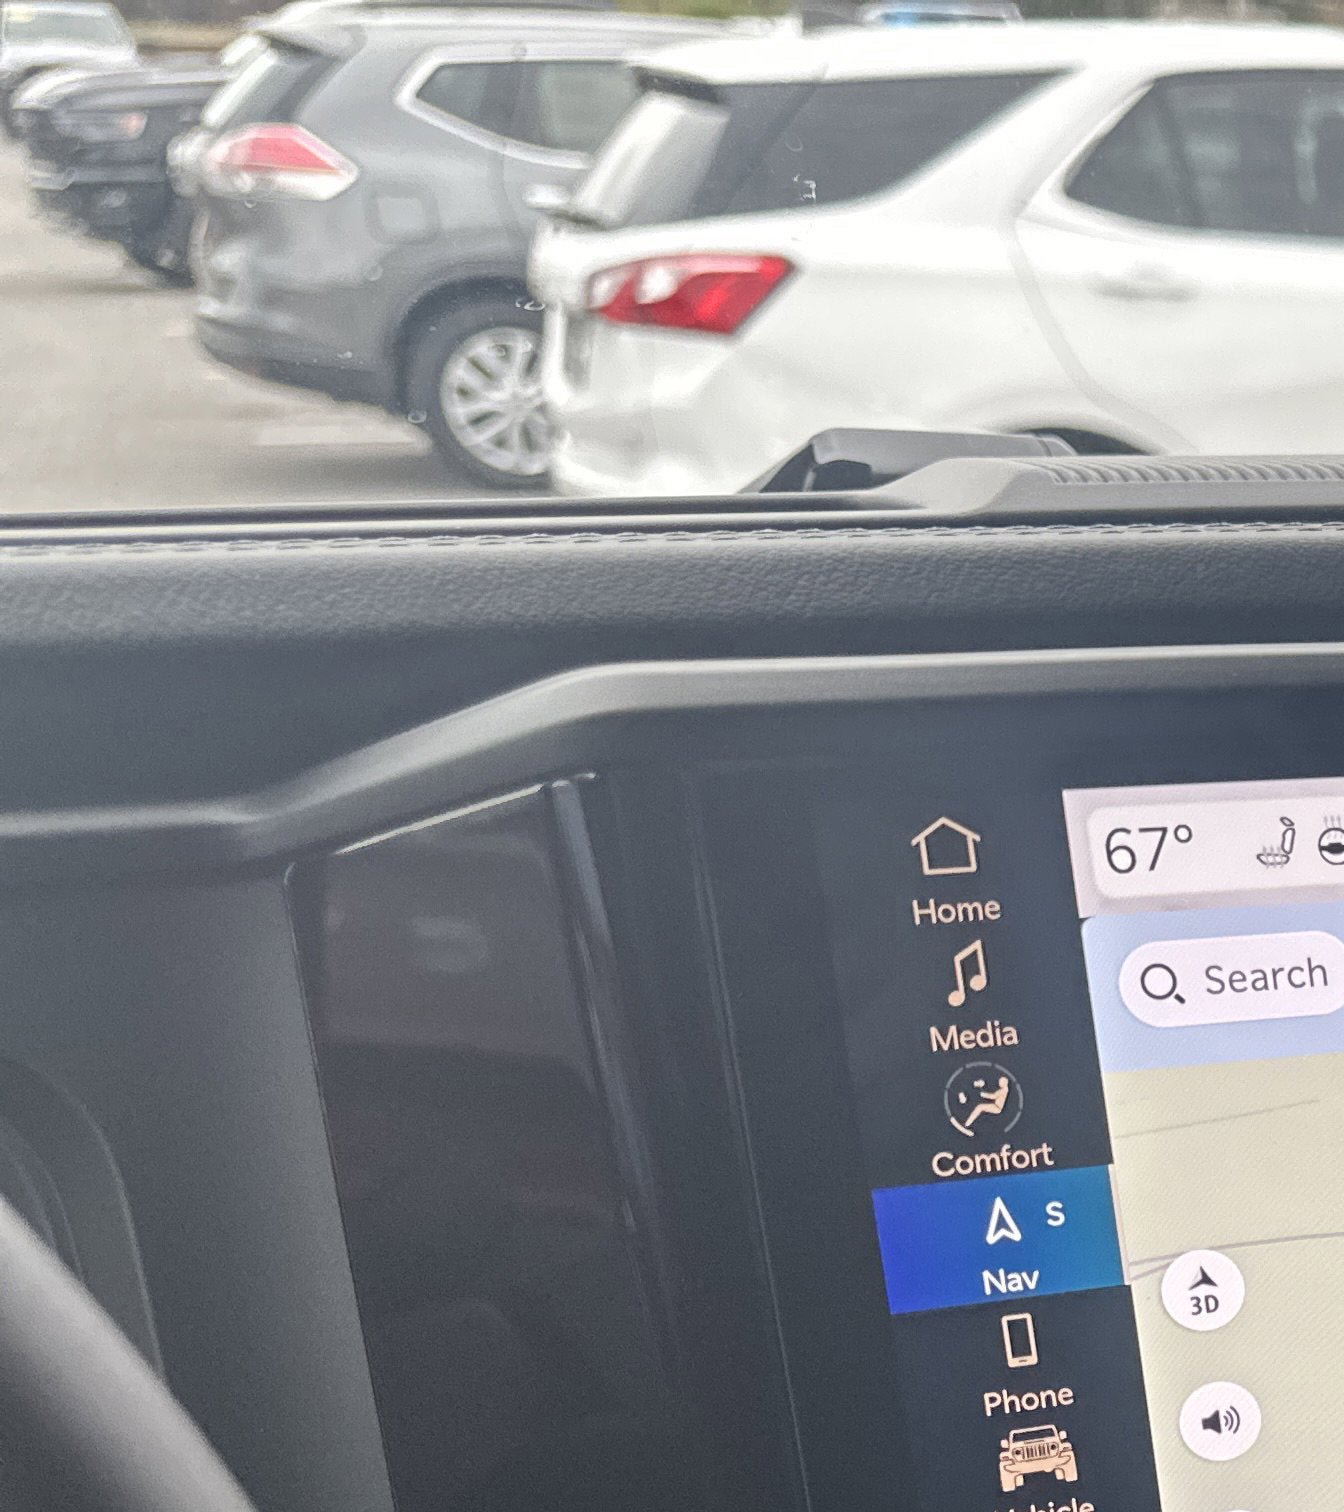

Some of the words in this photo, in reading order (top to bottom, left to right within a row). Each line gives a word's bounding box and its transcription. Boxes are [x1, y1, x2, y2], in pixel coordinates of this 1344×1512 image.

[911, 898, 1002, 926] Home
[1203, 956, 1330, 997] Search
[929, 1021, 1019, 1052] Media
[932, 1143, 1055, 1177] Comfort
[1045, 1202, 1065, 1226] S
[982, 1269, 1040, 1295] Nav
[1190, 1295, 1220, 1316] 3D
[983, 1386, 1075, 1417] Phone
